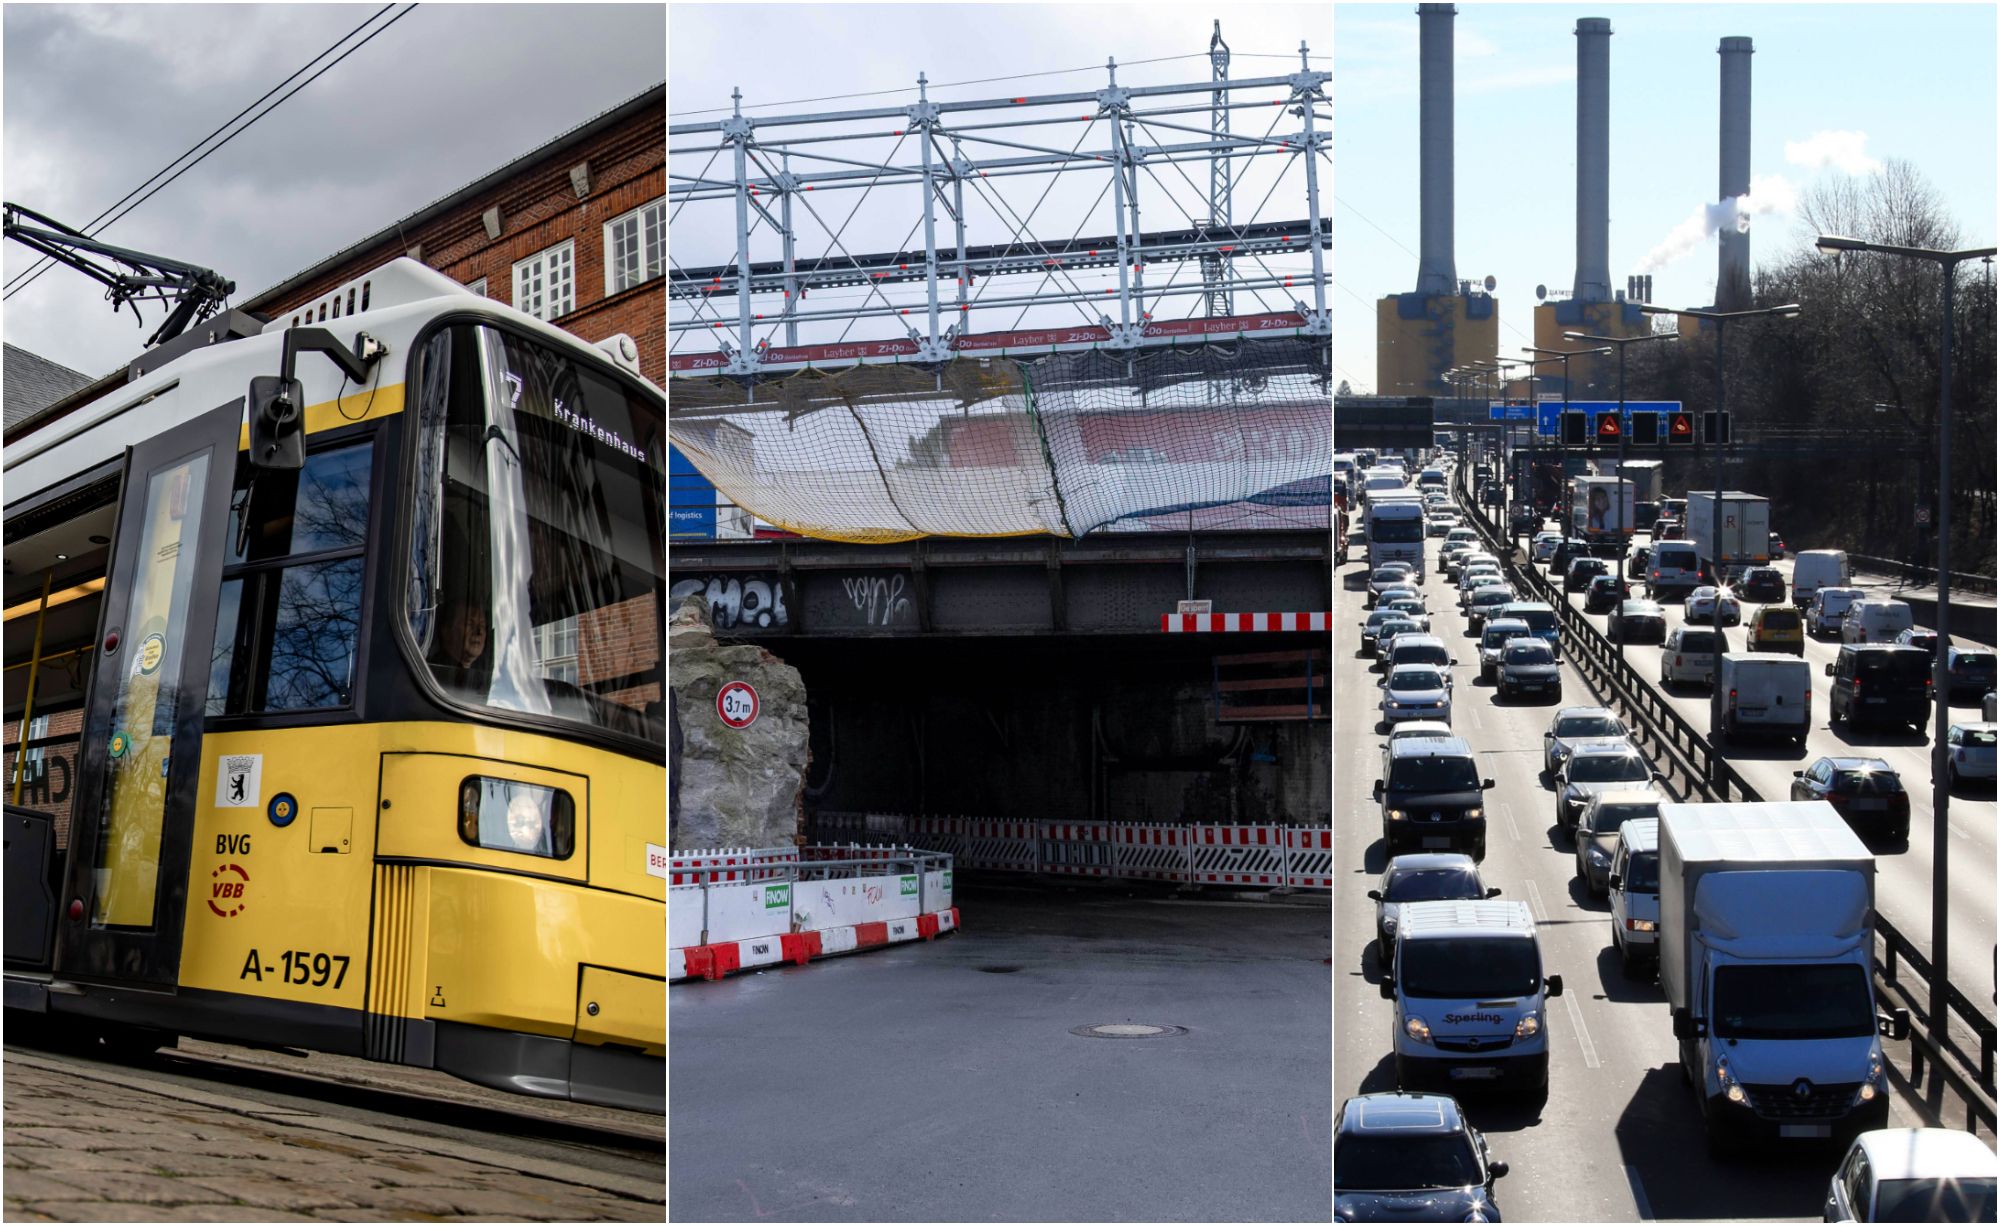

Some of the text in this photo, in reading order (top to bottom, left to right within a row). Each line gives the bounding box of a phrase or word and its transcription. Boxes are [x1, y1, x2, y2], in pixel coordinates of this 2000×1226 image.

[554, 398, 646, 462] Krankenhaus
[674, 511, 702, 520] logistics
[742, 704, 751, 714] m
[216, 834, 251, 855] BVG
[212, 883, 244, 898] VBB
